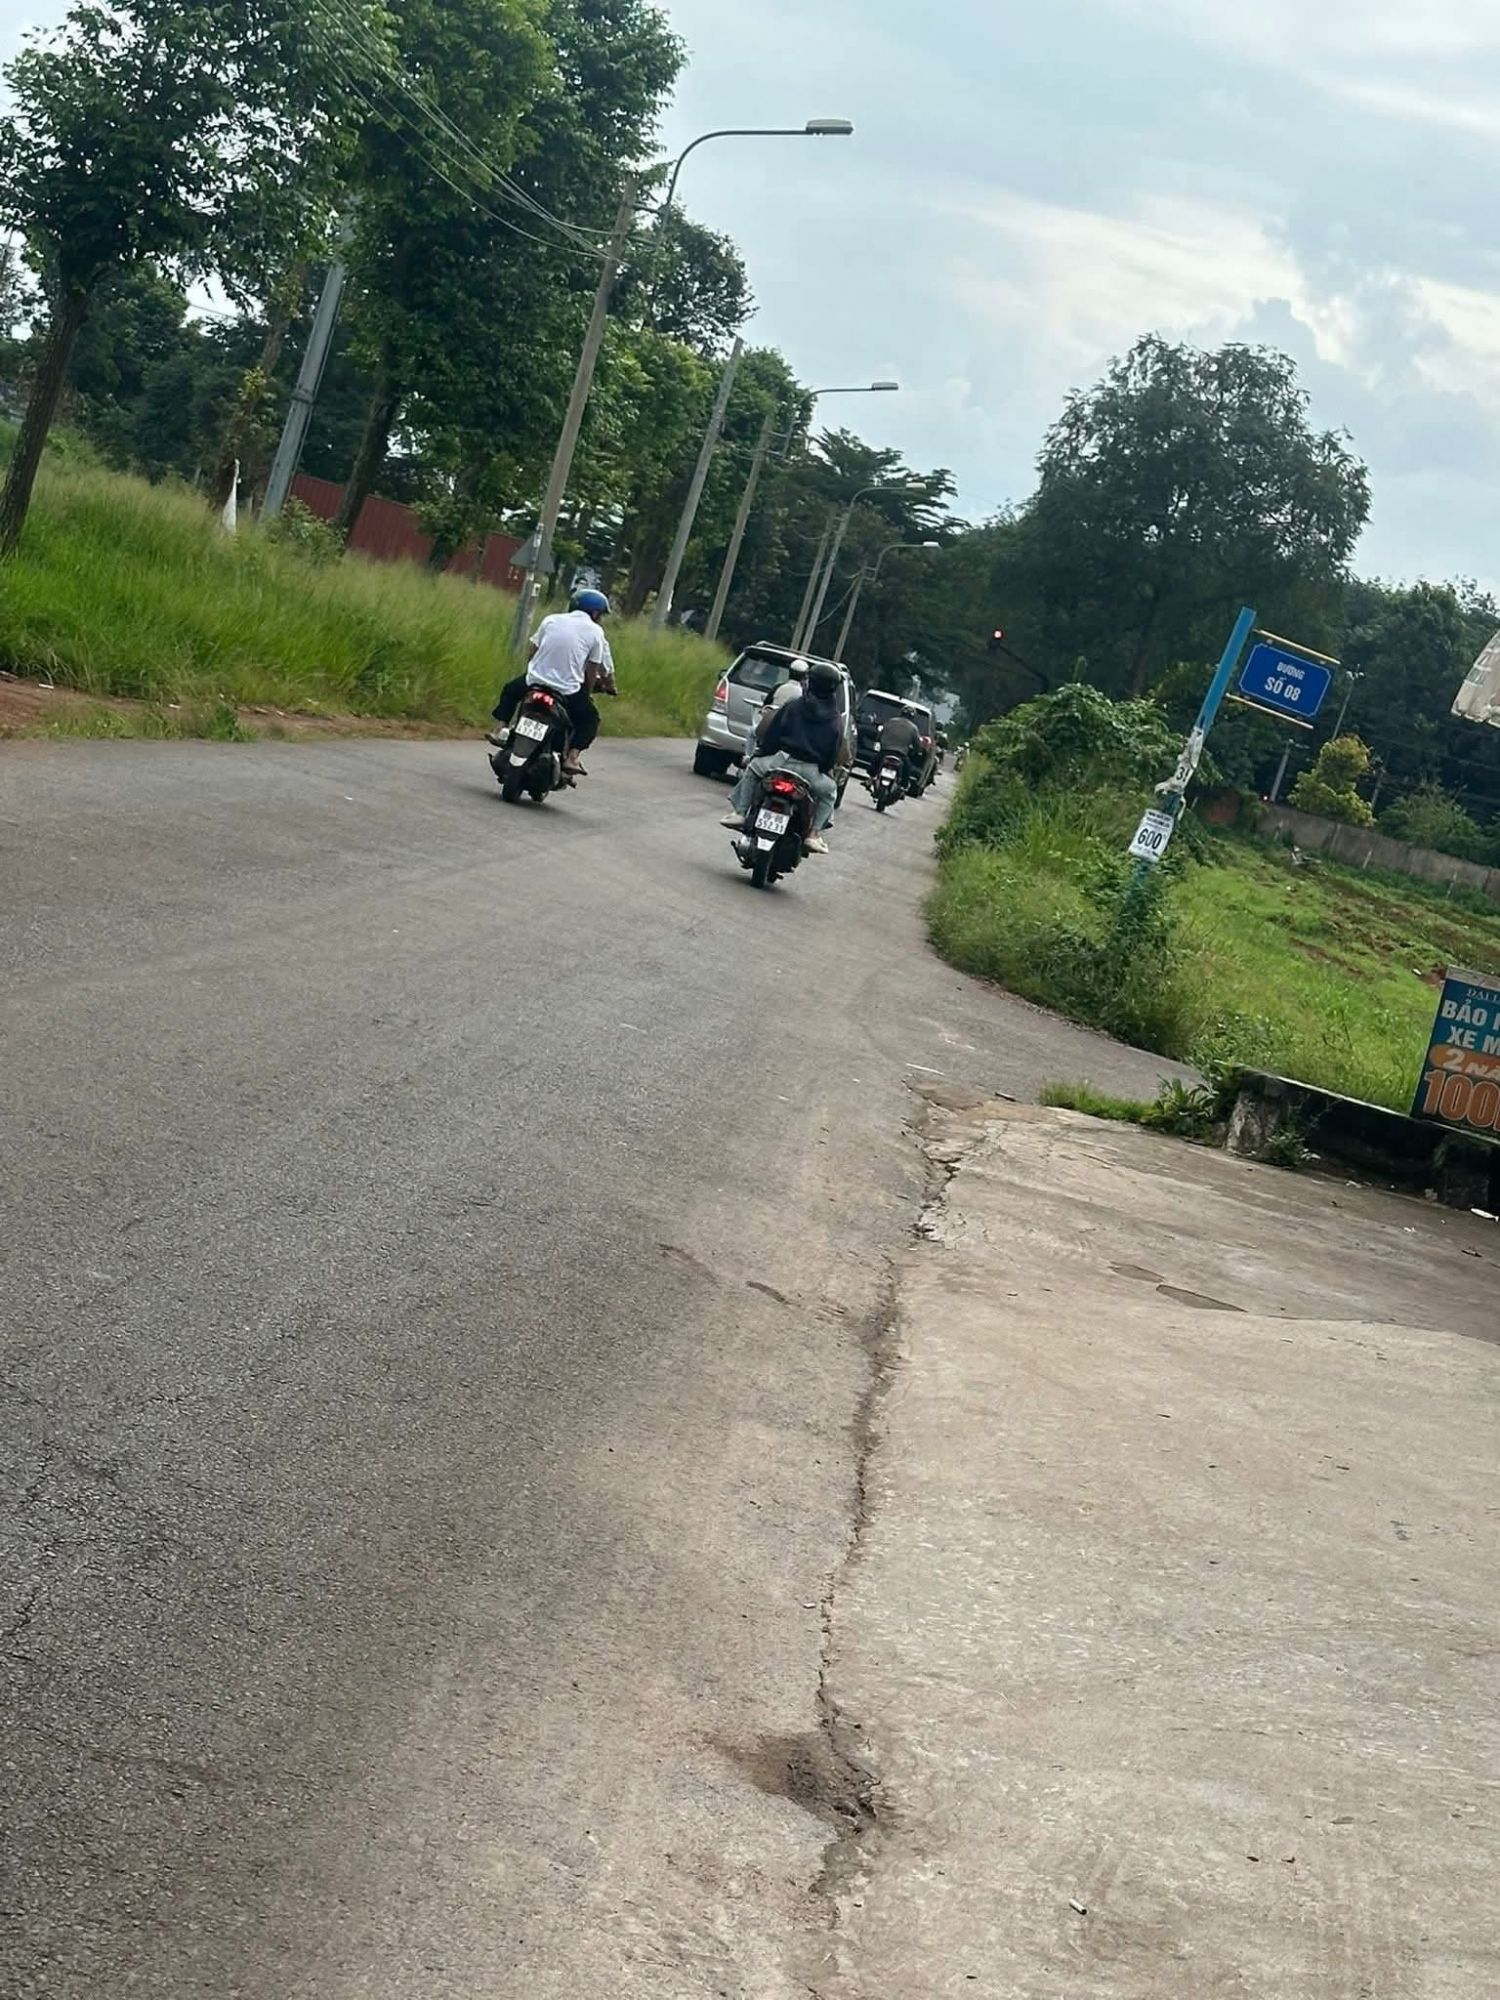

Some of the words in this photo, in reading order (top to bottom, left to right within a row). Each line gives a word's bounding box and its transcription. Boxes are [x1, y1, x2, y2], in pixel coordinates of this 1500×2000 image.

[1264, 675, 1287, 694] SỐ
[1284, 684, 1301, 701] 08
[1138, 828, 1162, 849] 600
[1441, 998, 1488, 1026] BẢO
[1446, 1025, 1477, 1049] XE
[1443, 1048, 1465, 1071] 2
[1423, 1069, 1500, 1131] 100
